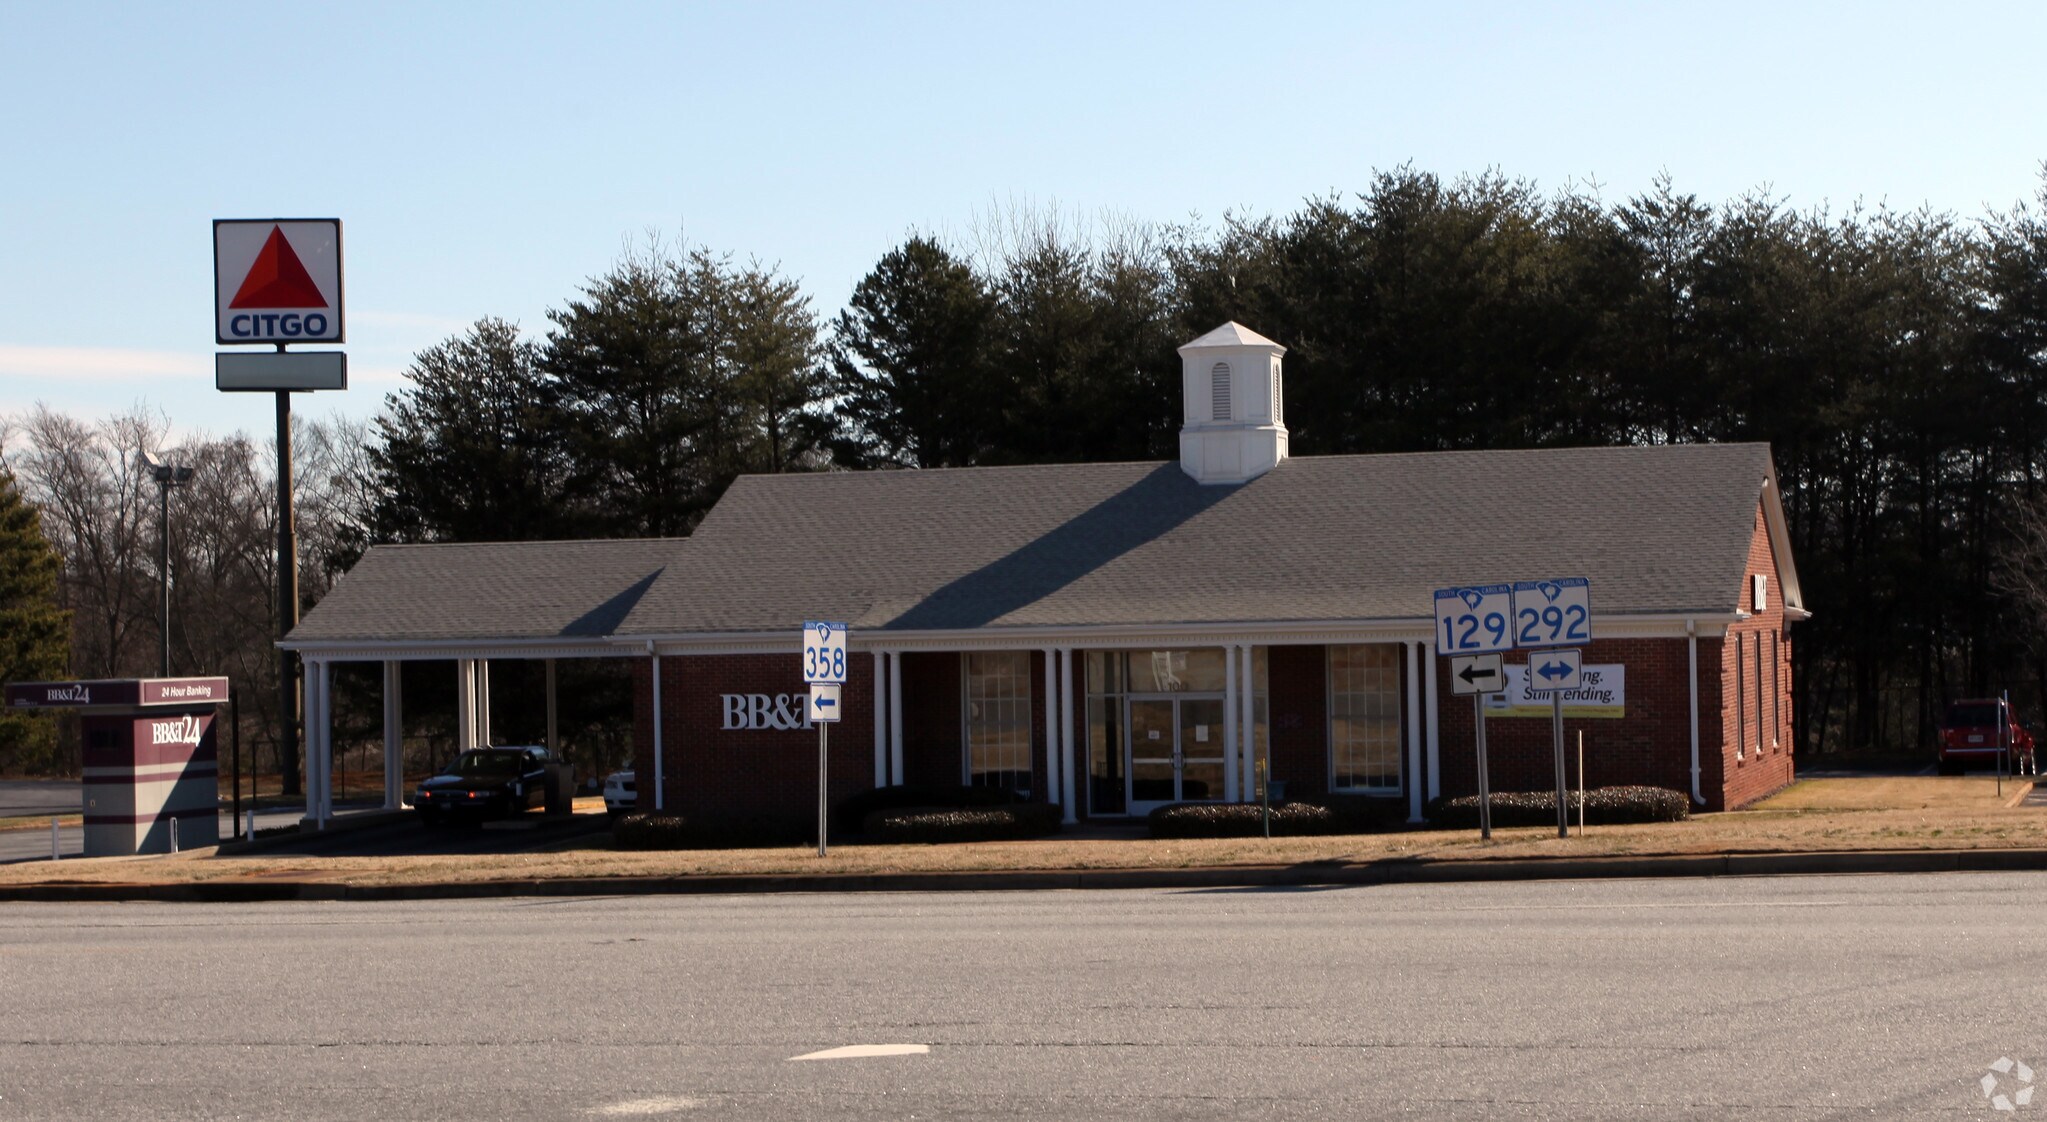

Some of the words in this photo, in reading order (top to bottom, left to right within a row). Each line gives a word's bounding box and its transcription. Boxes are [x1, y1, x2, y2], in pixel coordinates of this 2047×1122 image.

[231, 313, 328, 337] CITGO
[1443, 611, 1506, 650] 129
[1518, 604, 1588, 643] 292
[806, 646, 845, 679] 358
[161, 687, 170, 697] 24
[170, 686, 186, 697] Hour
[186, 685, 212, 698] Banking
[1561, 687, 1615, 704] ending.
[151, 713, 202, 747] BB&T24
